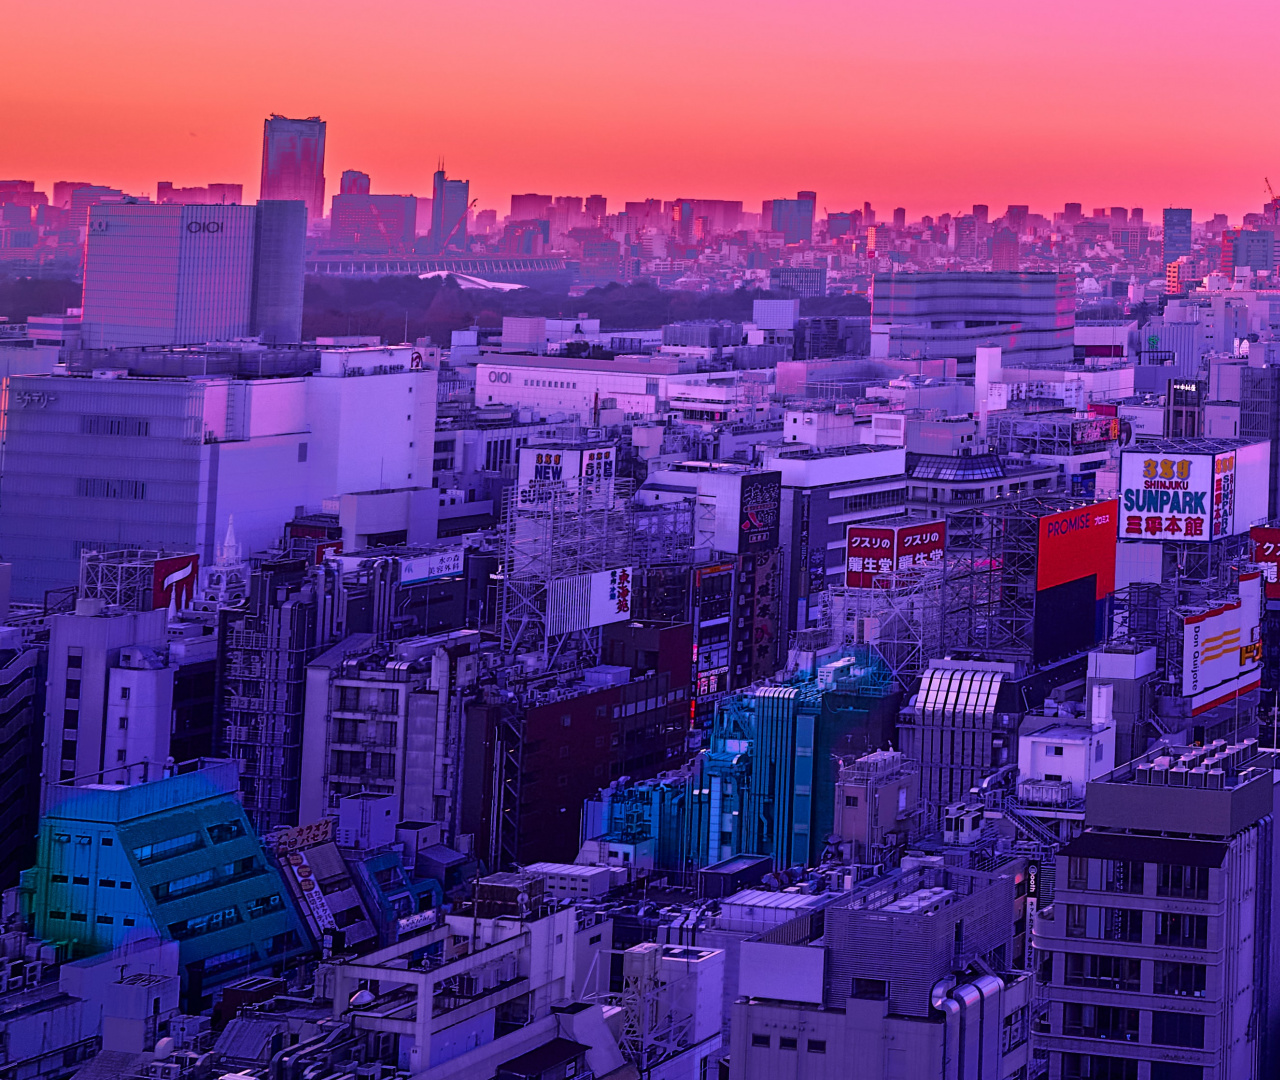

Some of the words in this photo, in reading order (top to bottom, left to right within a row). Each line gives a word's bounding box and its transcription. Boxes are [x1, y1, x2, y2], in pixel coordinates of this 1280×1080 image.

[535, 466, 562, 480] NEW
[1144, 458, 1193, 480] 389
[1144, 480, 1189, 490] SHINJUKU
[1124, 488, 1207, 515] SUNPARK
[1048, 513, 1090, 538] PROMISE
[1125, 515, 1204, 537] 三平本館
[851, 537, 891, 549] クスリの
[903, 532, 939, 548] クスリの
[848, 557, 893, 574] 龍生堂
[1193, 626, 1201, 648] Don
[1191, 651, 1200, 691] Quijote
